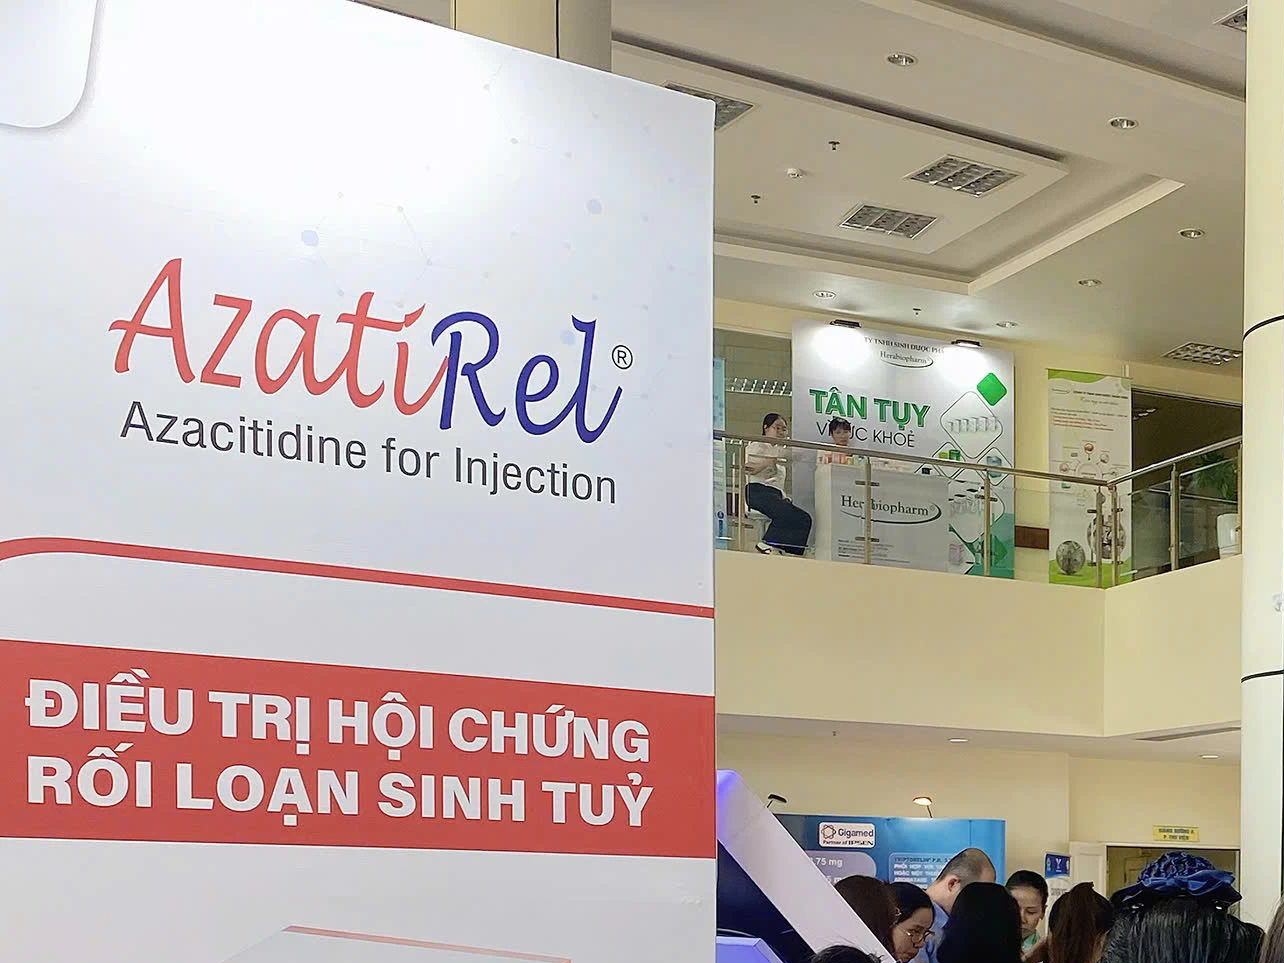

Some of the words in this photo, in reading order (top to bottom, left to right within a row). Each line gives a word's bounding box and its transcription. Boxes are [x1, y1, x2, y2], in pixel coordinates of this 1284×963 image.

[809, 387, 867, 420] TÂN
[873, 397, 931, 431] TỤY
[120, 401, 367, 470] Azacitidine
[381, 436, 440, 480] for
[455, 446, 617, 504] Injection
[873, 429, 916, 448] KHOẺ
[841, 494, 929, 515] Herbiopharm
[25, 668, 193, 736] ĐIỀU
[208, 691, 311, 755] TRỊ
[327, 691, 434, 761] HỘI
[448, 704, 651, 762] CHỨNG
[26, 742, 153, 809] RỐI
[176, 762, 359, 827] LOẠN
[377, 773, 526, 823] SINH
[541, 772, 653, 828] TUỶ
[838, 828, 874, 838] Gigamed
[829, 859, 843, 868] mg
